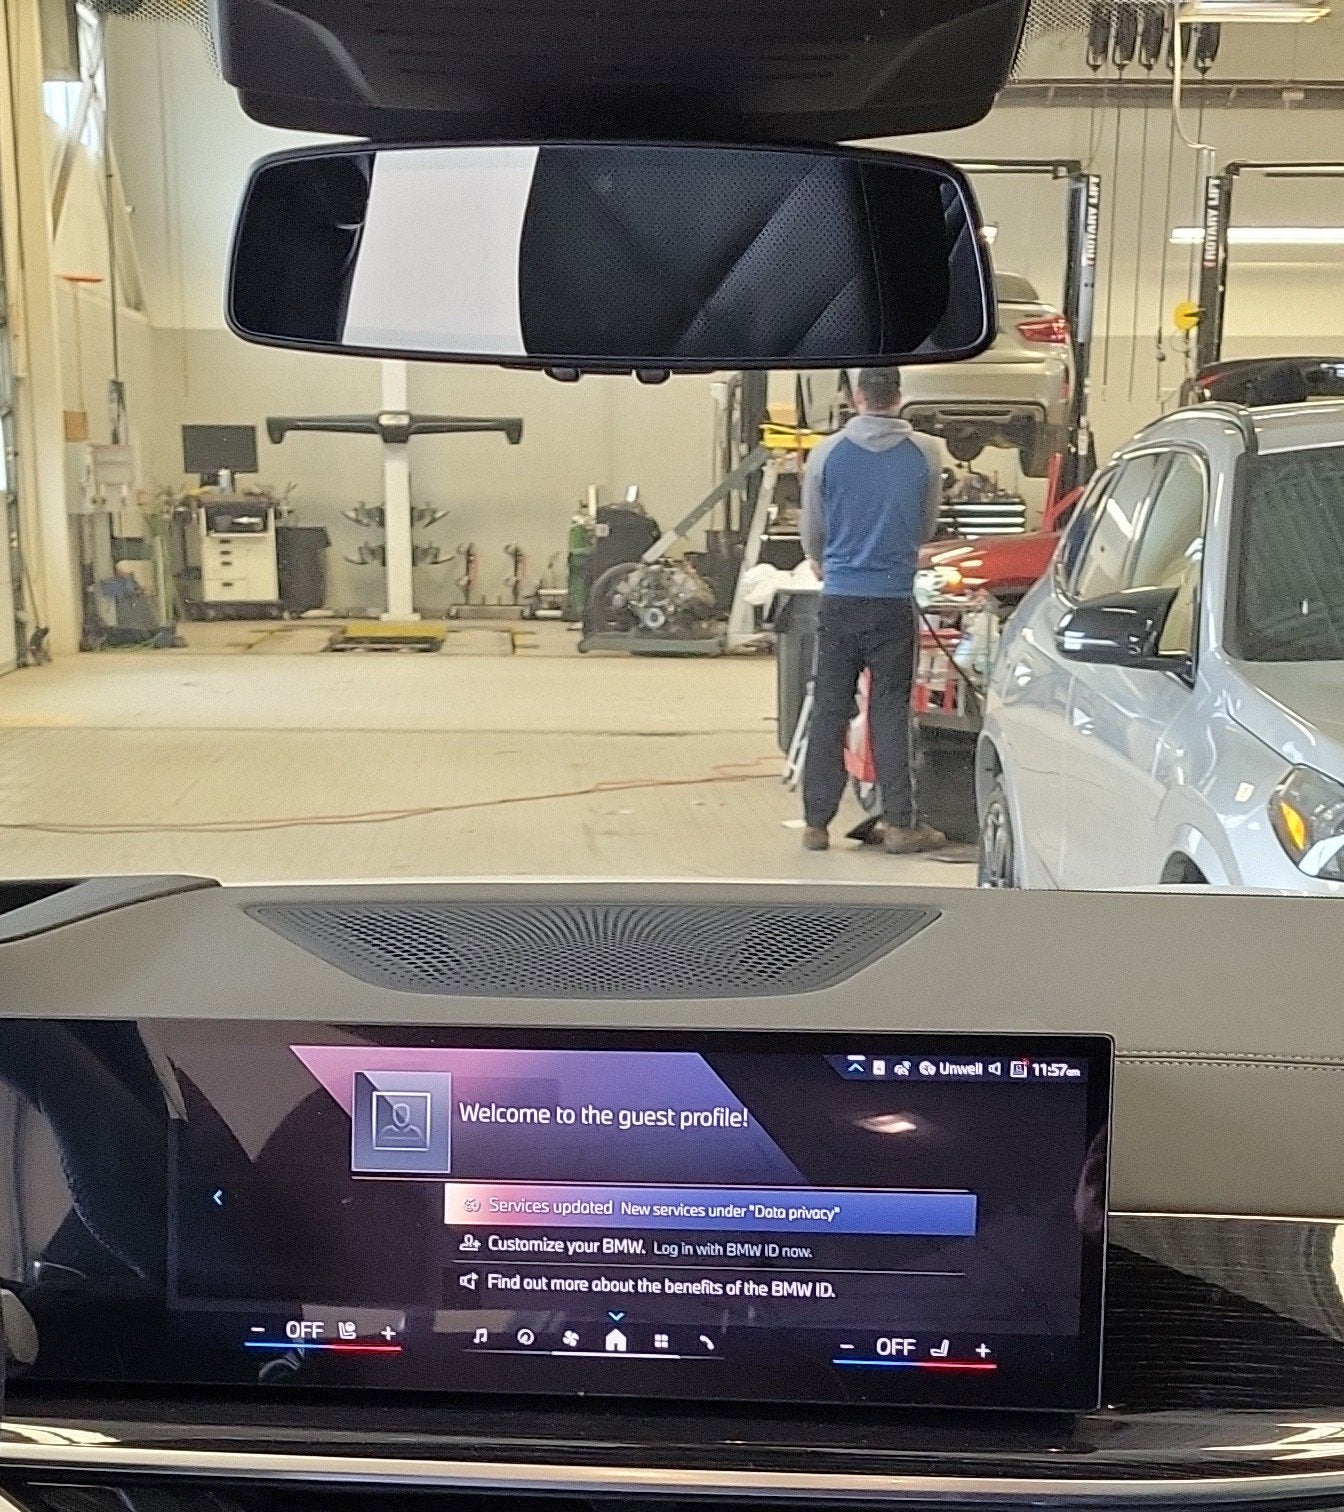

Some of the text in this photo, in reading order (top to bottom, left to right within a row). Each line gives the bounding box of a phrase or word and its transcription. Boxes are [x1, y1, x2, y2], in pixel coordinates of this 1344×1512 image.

[939, 1061, 983, 1075] Unwell
[459, 1102, 748, 1130] Welcome to the guest profile!
[489, 1197, 840, 1222] Services updated New services under "Data privacy"
[488, 1235, 813, 1258] Customize your BMW. Log in with BMW ID now.
[487, 1274, 836, 1298] Find out more about the benefits of the BMW ID.
[286, 1321, 325, 1338] OFF
[876, 1337, 917, 1356] OFF
